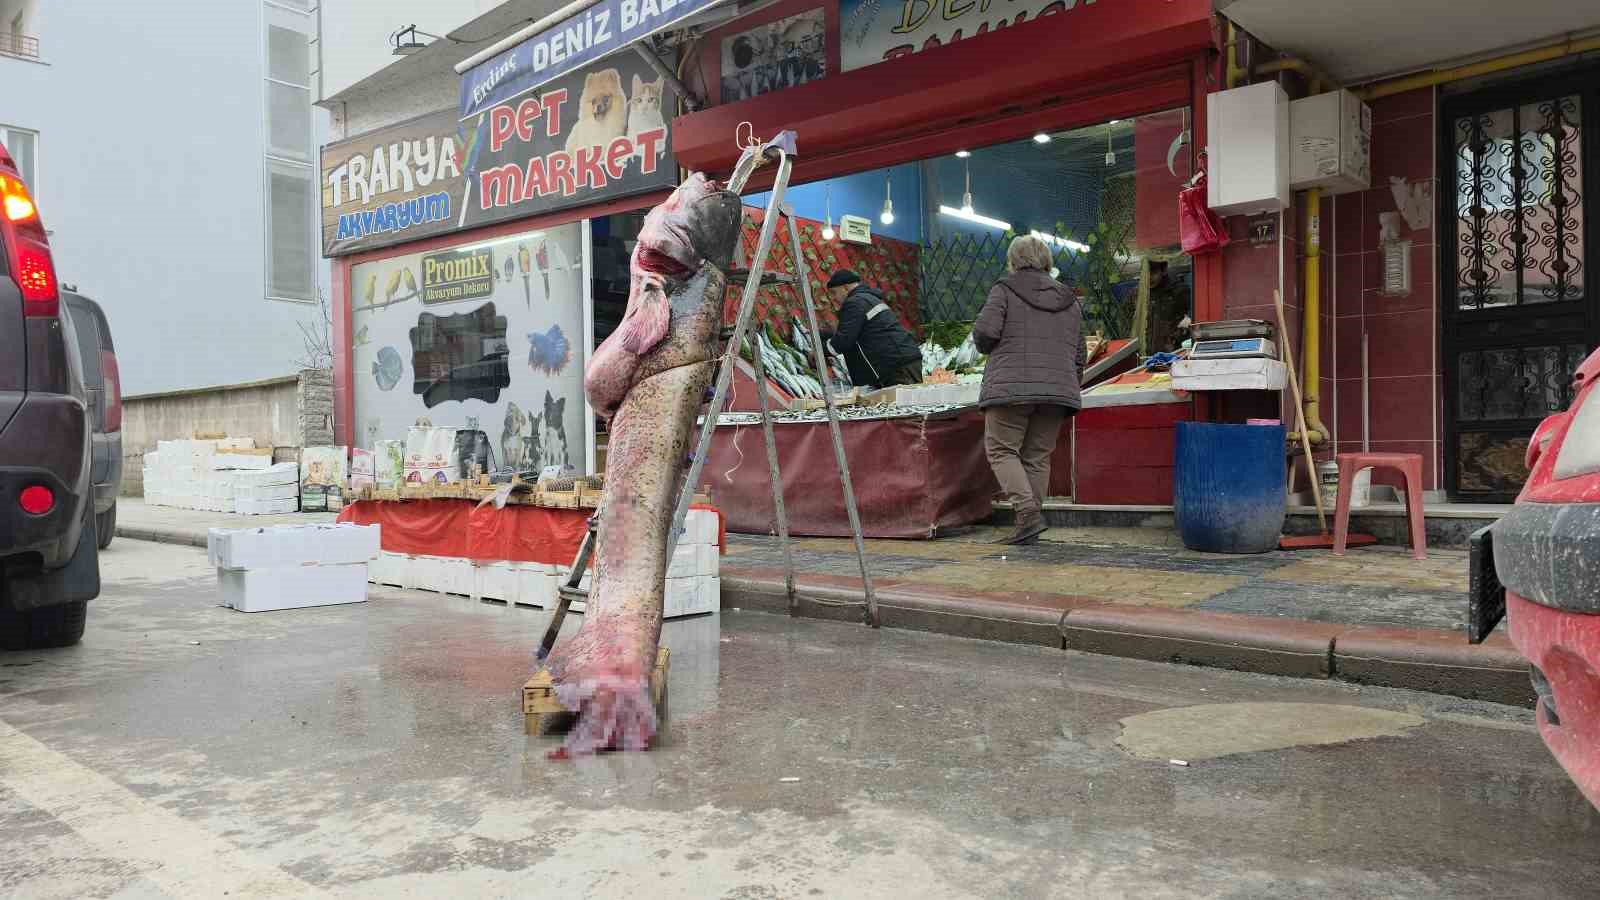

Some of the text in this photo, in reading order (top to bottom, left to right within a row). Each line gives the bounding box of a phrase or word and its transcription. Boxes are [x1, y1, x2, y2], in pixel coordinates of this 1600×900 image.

[473, 54, 517, 106] Erdinç
[533, 12, 612, 72] DENİZ
[328, 136, 460, 208] TRAKYA
[337, 191, 451, 240] AKVARYUM
[424, 256, 490, 286] Promix
